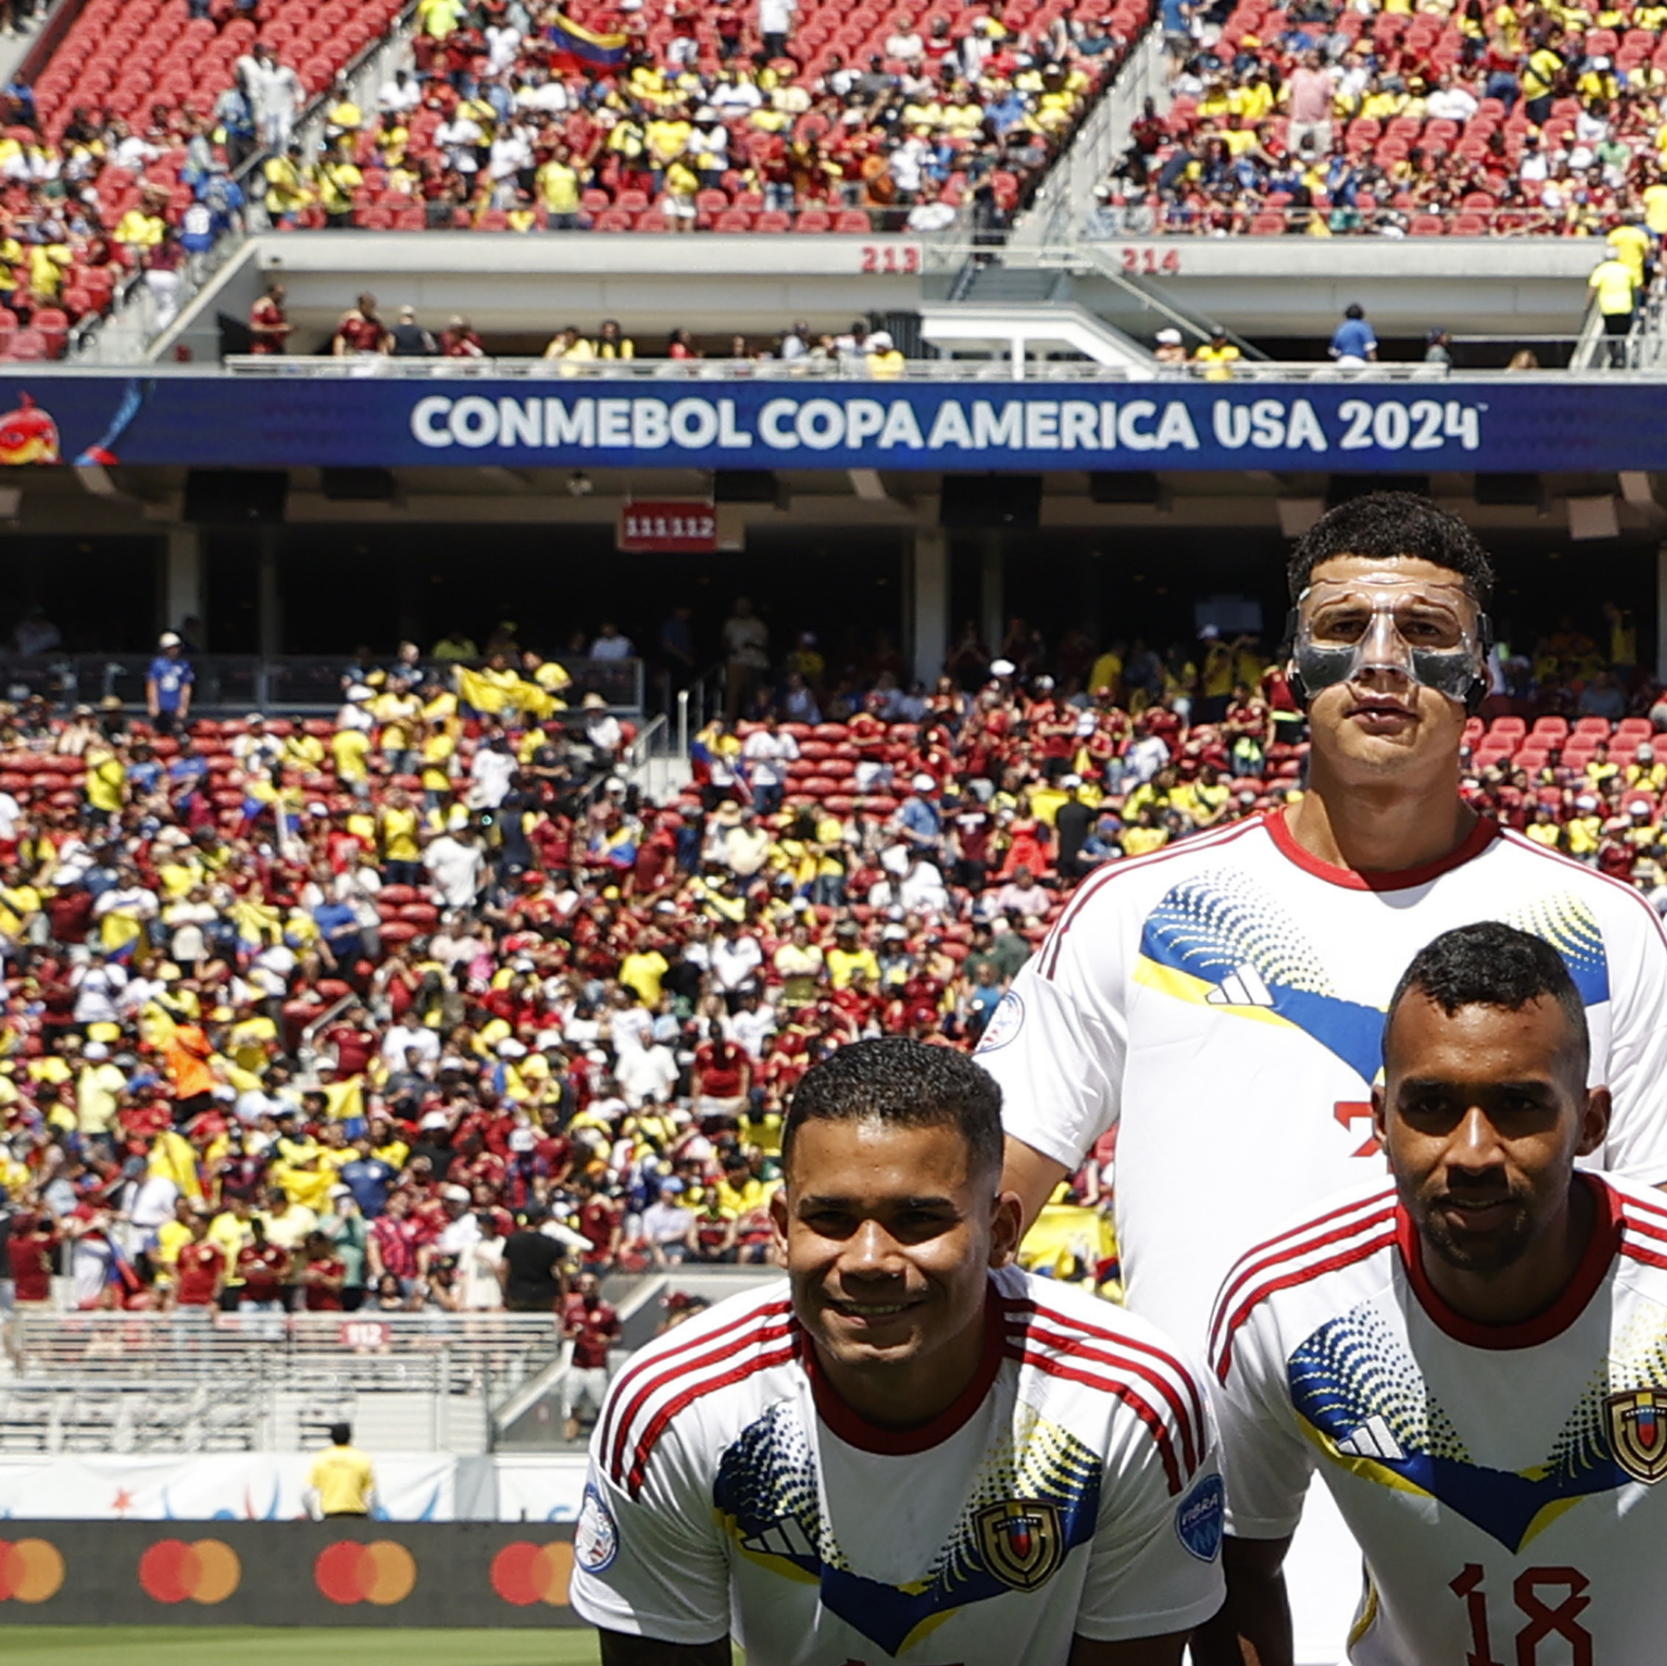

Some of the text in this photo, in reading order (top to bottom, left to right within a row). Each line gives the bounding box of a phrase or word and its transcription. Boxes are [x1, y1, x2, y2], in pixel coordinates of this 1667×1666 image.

[862, 247, 919, 273] 213
[412, 397, 750, 448] CONMEBOL
[759, 399, 923, 450] COPA
[930, 400, 1199, 450] AMERICA
[1214, 399, 1327, 452] USA
[626, 516, 667, 538] 111
